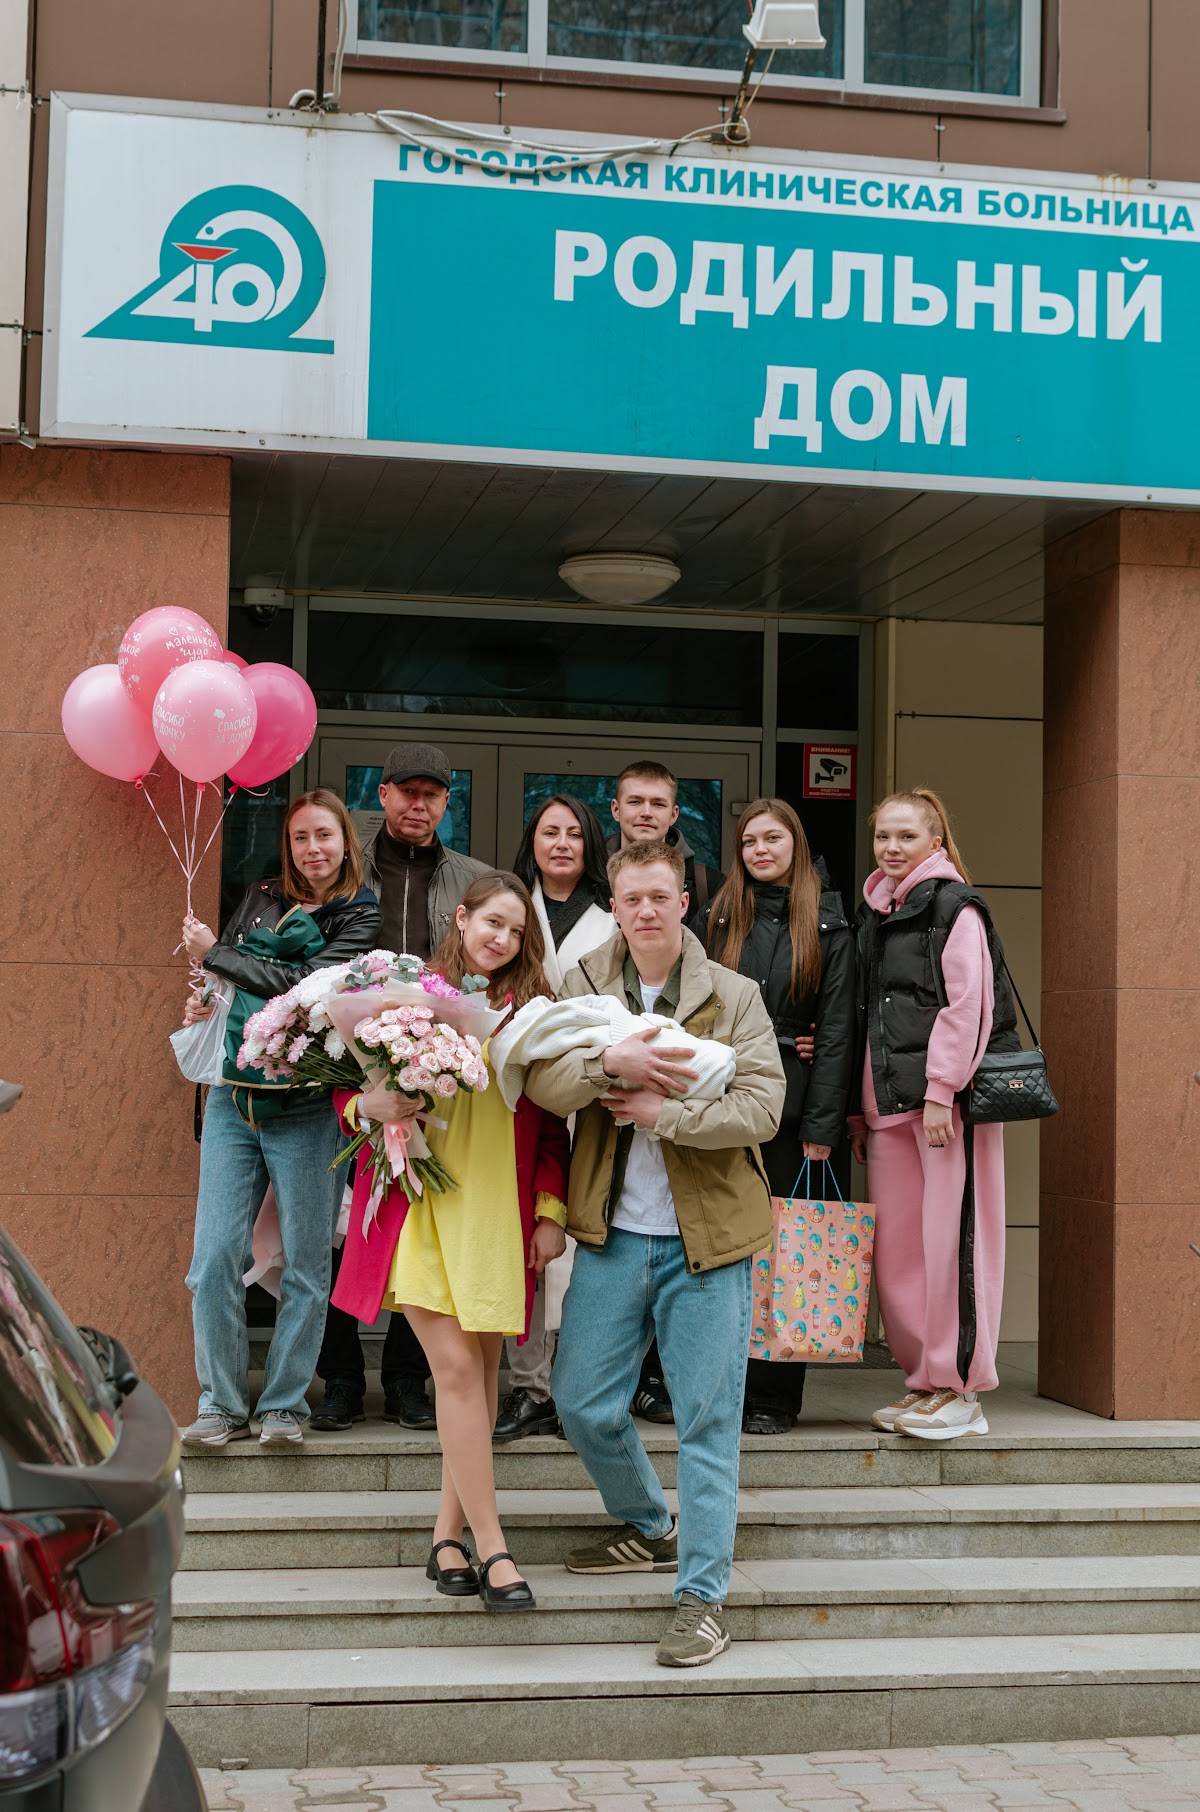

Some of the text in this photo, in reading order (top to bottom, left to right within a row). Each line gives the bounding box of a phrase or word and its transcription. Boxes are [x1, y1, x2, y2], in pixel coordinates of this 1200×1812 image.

[399, 143, 1195, 235] ГОРОДСКАЯ КЛИНИЧЕСКАЯ БОЛЬНИЦА
[129, 263, 276, 333] 40
[553, 229, 1163, 343] РОДИЛЬНЫЙ
[753, 364, 968, 453] ДОМ
[165, 635, 217, 650] маленькое
[218, 715, 251, 733] СПАСИБО
